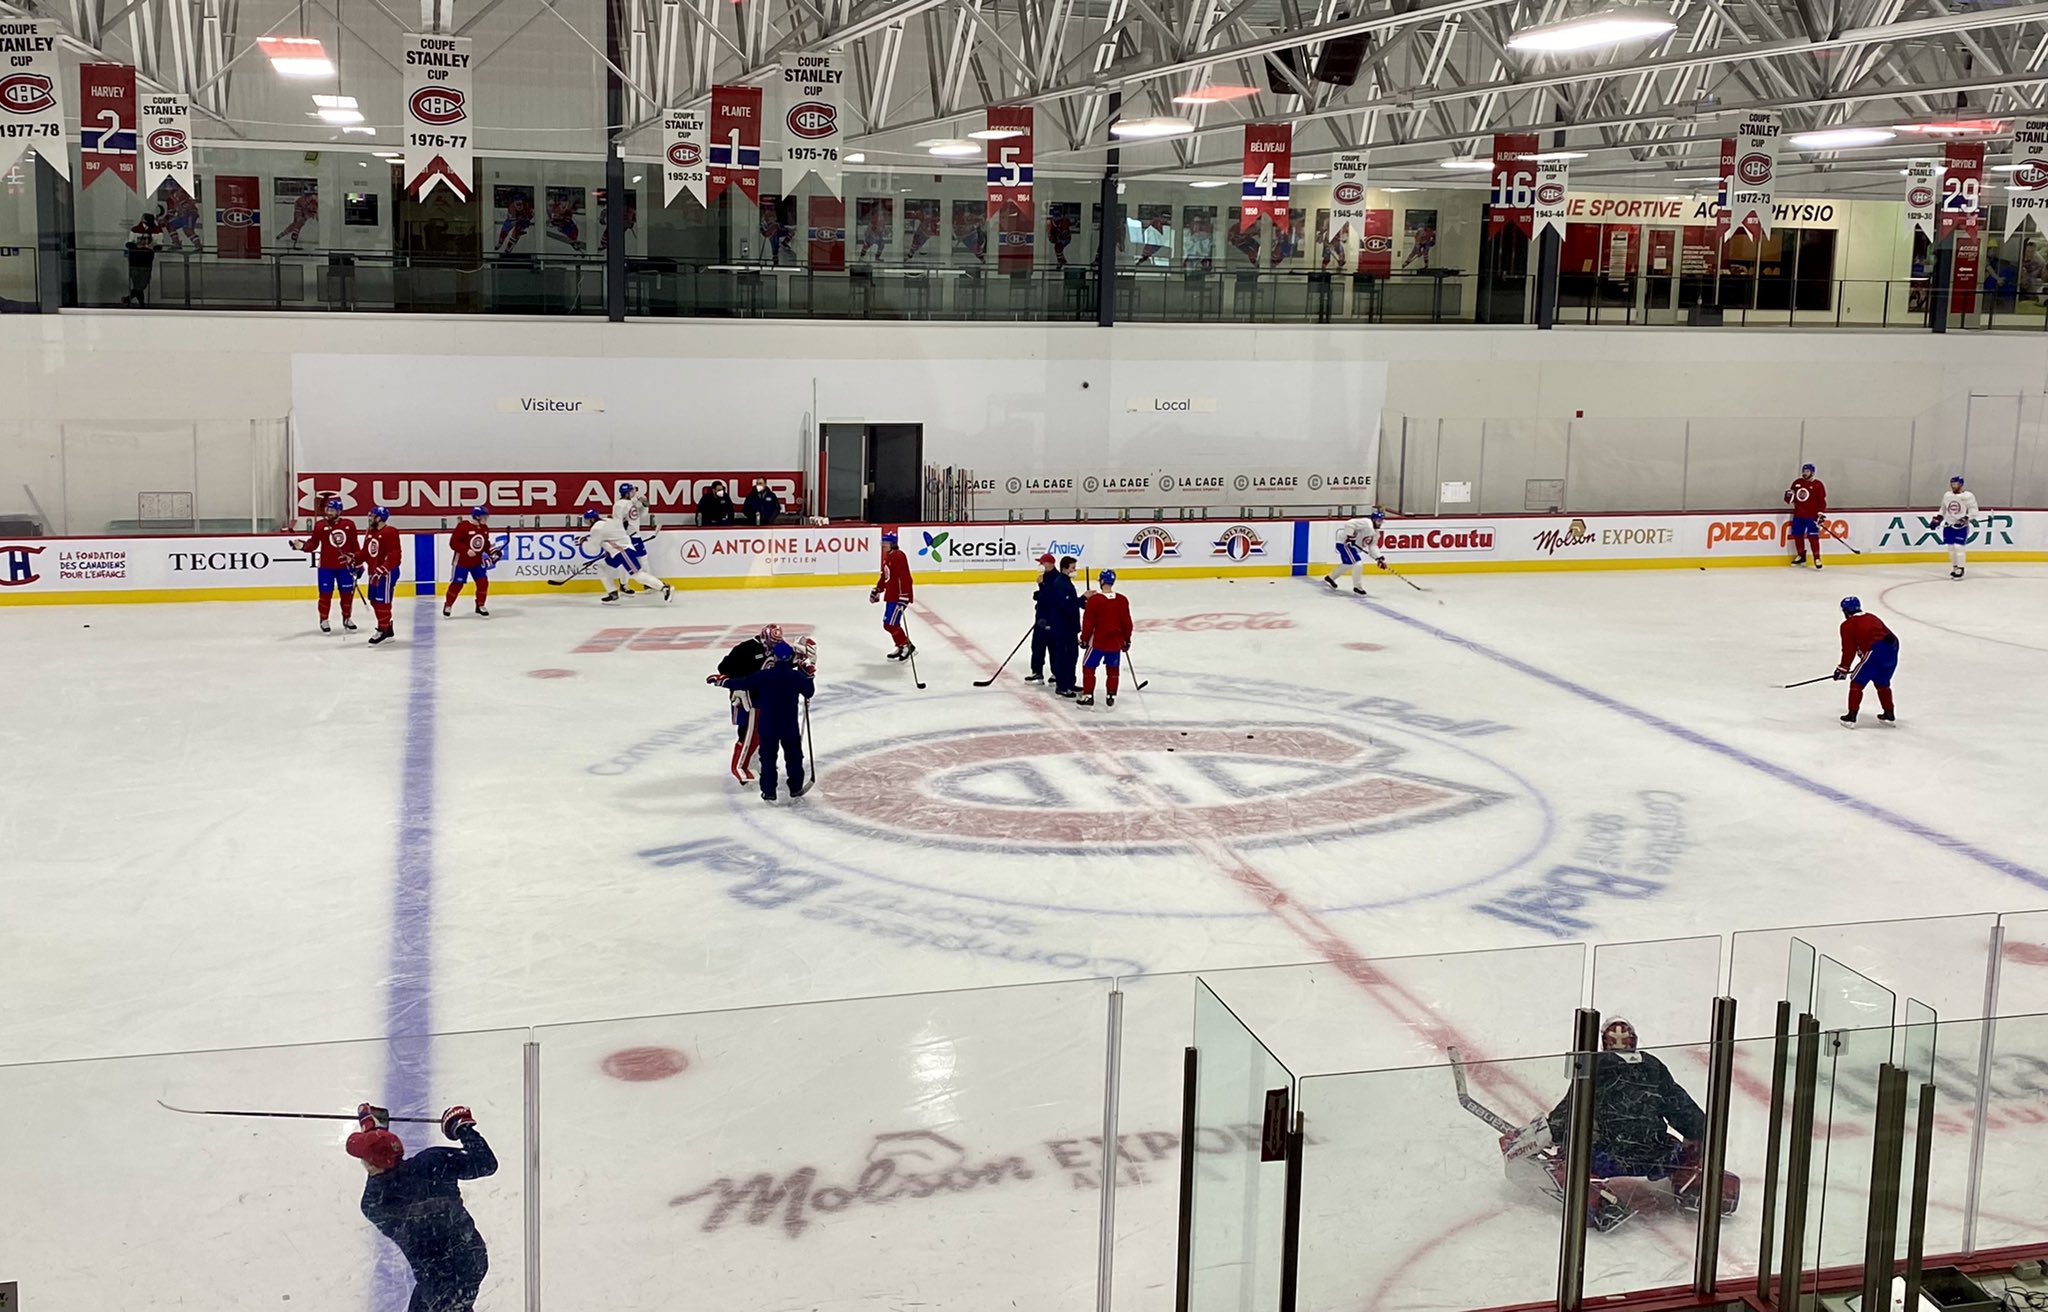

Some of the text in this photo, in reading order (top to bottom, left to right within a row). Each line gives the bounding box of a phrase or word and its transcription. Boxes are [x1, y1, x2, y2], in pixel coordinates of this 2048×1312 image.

[0, 24, 38, 35] COUPE
[0, 37, 54, 52] TANLEY
[421, 39, 456, 51] COUPE
[10, 56, 33, 67] CUP
[406, 50, 470, 68] STANLEY
[797, 56, 830, 68] COUPE
[427, 69, 449, 80] CUP
[784, 69, 843, 84] STANLEY
[91, 86, 125, 98] HARVEY
[804, 86, 823, 96] CUP
[152, 96, 178, 105] COUPE
[143, 105, 188, 115] STANLEY
[721, 105, 752, 118] PLANTE
[158, 117, 175, 125] CUP
[673, 112, 695, 120] COUPE
[1749, 113, 1771, 124] COUPE
[0, 123, 60, 138] 1977-78
[664, 120, 704, 130] STANLEY
[1739, 123, 1780, 137] STANLEY
[97, 109, 120, 155] 2
[677, 131, 692, 139] CUP
[2014, 131, 2048, 143] STANL
[410, 133, 467, 148] 1976-77
[1751, 139, 1766, 148] CUP
[727, 128, 743, 170] 1
[787, 147, 838, 161] 1975-76
[2028, 145, 2044, 154] CUP
[85, 161, 100, 171] 1947
[149, 160, 189, 170] 1956-57
[1000, 147, 1021, 187] 5
[1333, 162, 1368, 171] STANLEY
[1537, 164, 1568, 172] STANLEY
[667, 173, 703, 182] 1952-53
[1254, 162, 1278, 202] 4
[1496, 171, 1533, 209] 16
[1943, 177, 1980, 213] 29
[1736, 193, 1771, 204] 1972-73
[1333, 209, 1363, 218] 1945-46
[1536, 210, 1564, 218] 1943-44
[1589, 199, 1683, 218] SPORTIVE
[521, 398, 582, 411] Visiteur
[1154, 398, 1191, 411] Local
[1026, 479, 1073, 489] LA CAGE
[1103, 477, 1150, 488] LA CAGE
[1178, 477, 1225, 487] LA CAGE
[1253, 476, 1298, 486] LA CAGE
[1327, 476, 1371, 486] LA CAGE
[372, 479, 557, 507] UNDER
[1377, 529, 1493, 549] Jean Coutu
[1707, 519, 1849, 549] pizza pza
[515, 533, 606, 562] ESSO
[711, 537, 869, 555] ANTOINE LAOUN
[949, 537, 1017, 557] kersia
[1532, 528, 1666, 556] Molson EXPORT
[59, 550, 126, 561] LA FONDATION
[765, 556, 817, 564] OPTICIEN
[60, 560, 126, 570] DES CANADIENS
[60, 569, 127, 579] POUR L'ENFANCE
[1339, 695, 1518, 738] Bell
[669, 1158, 1036, 1240] Molson
